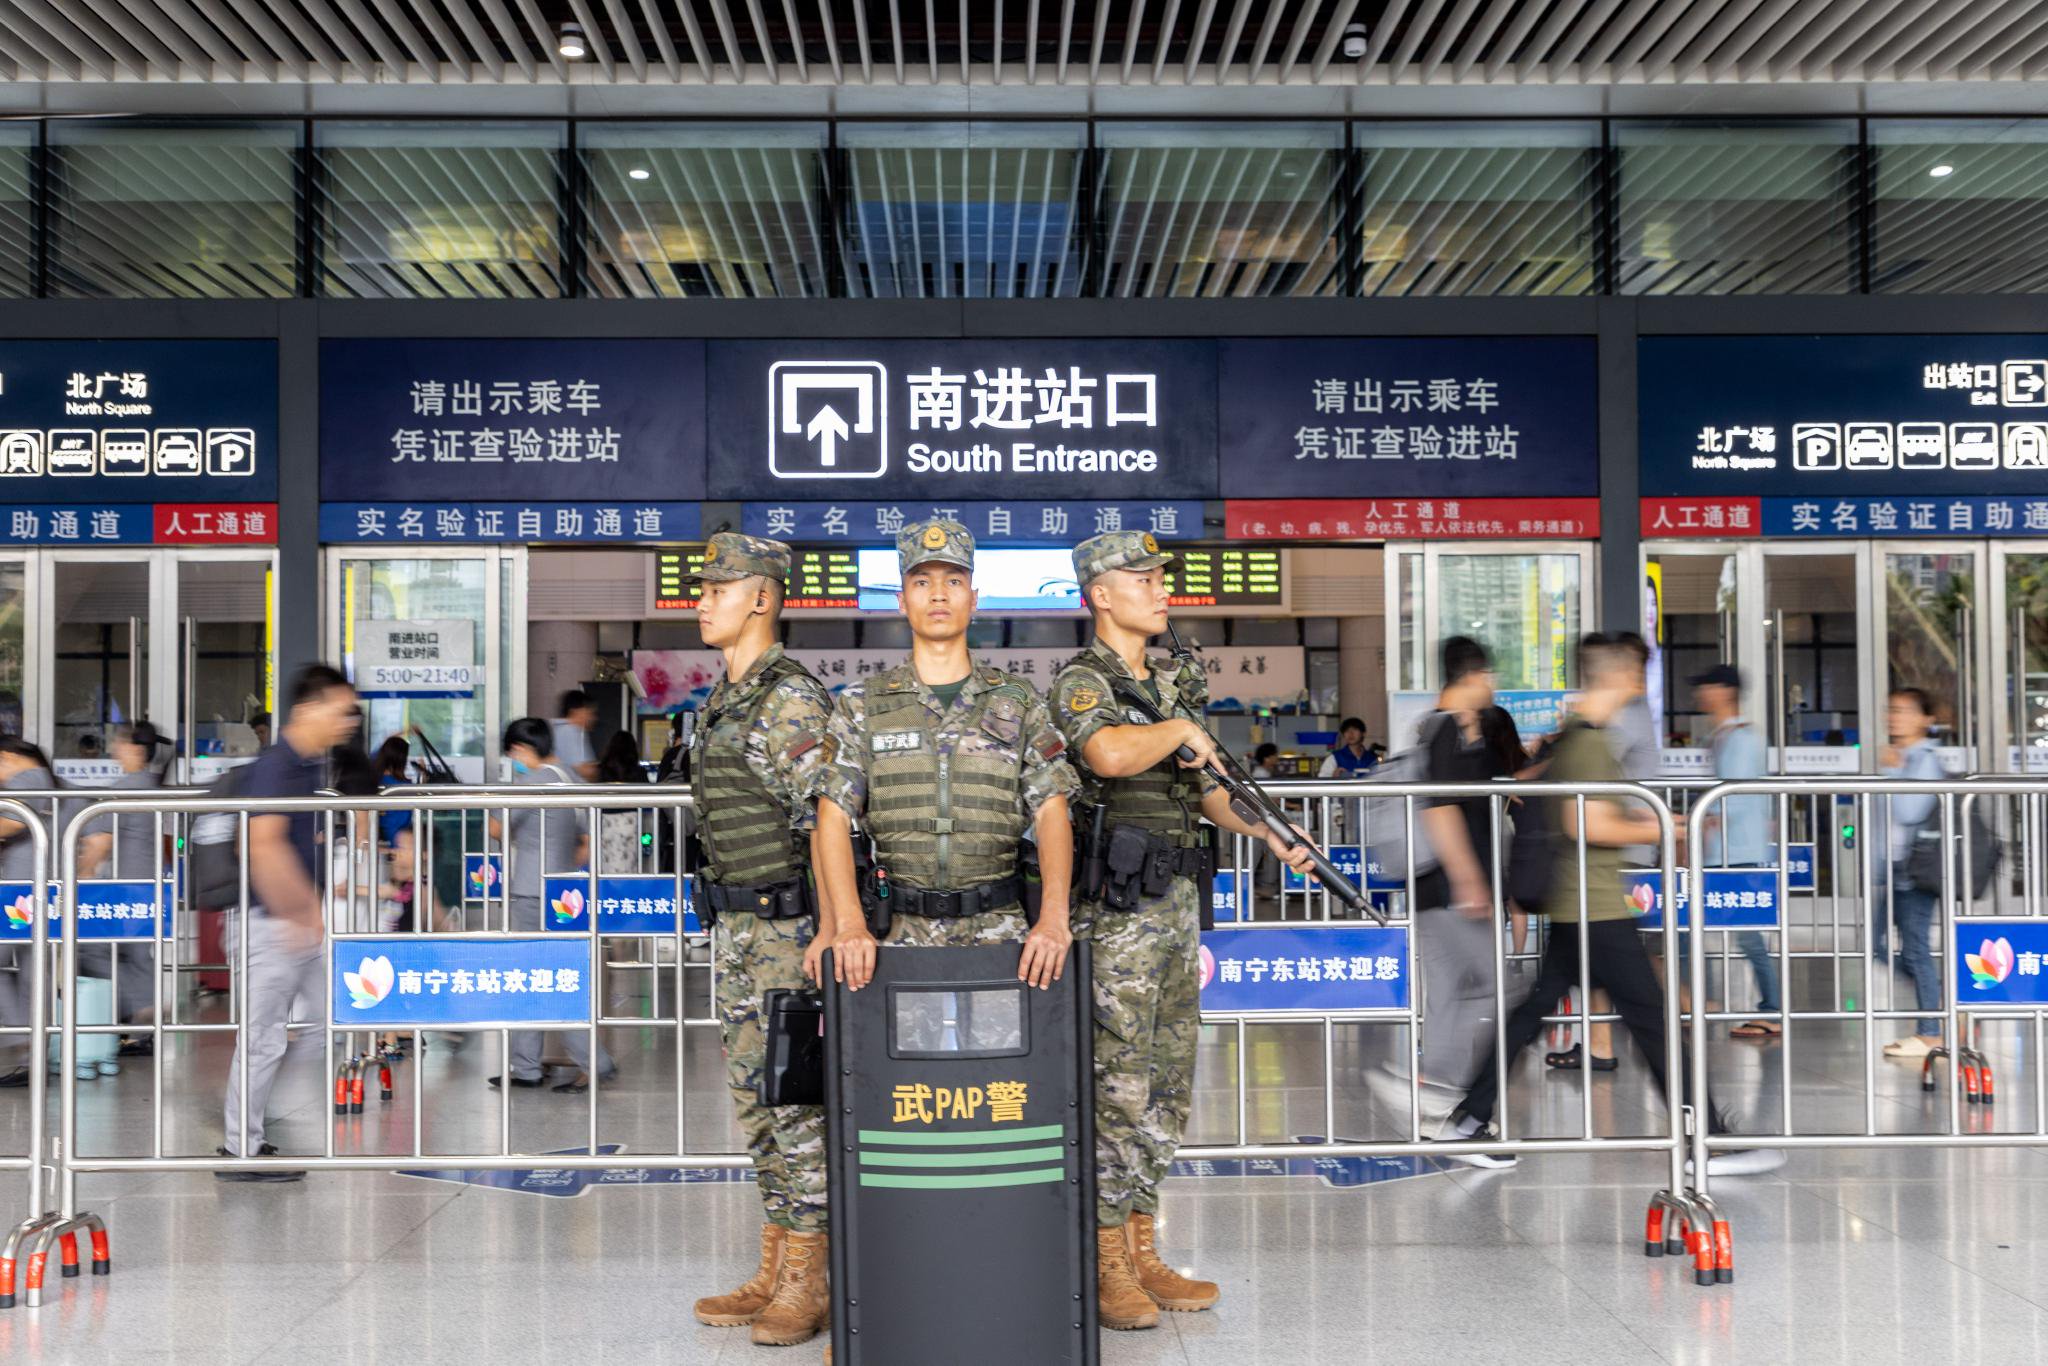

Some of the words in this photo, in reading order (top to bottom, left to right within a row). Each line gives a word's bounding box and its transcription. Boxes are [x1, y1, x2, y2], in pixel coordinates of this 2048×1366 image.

[66, 372, 147, 399] 北广场
[1923, 363, 1997, 389] 出站口
[66, 402, 101, 416] North
[104, 402, 152, 417] Square
[410, 380, 602, 417] 请出示乘车
[907, 366, 1157, 431] 南进站口
[1312, 378, 1500, 414] 请出示乘车
[390, 426, 621, 464] 凭证查验进站
[1293, 425, 1520, 461] 凭证查验进站
[1698, 426, 1776, 453] 北广场
[907, 443, 1001, 473] South
[1012, 443, 1158, 473] Entrance
[165, 512, 266, 536] 人工通道
[356, 507, 663, 537] 实名验证自助通道
[1366, 502, 1461, 519] 人工通道
[1652, 505, 1751, 528] 人工通道
[1792, 502, 2048, 530] 实名验证自助通
[10, 511, 120, 539] 助通道
[389, 632, 439, 645] 南进站口
[389, 648, 440, 660] 营业时间
[376, 668, 469, 684] 5:00~21:40
[1219, 956, 1400, 983] 南宁东站欢迎您
[2016, 951, 2048, 976] 南
[398, 968, 581, 994] 南宁东站欢迎您
